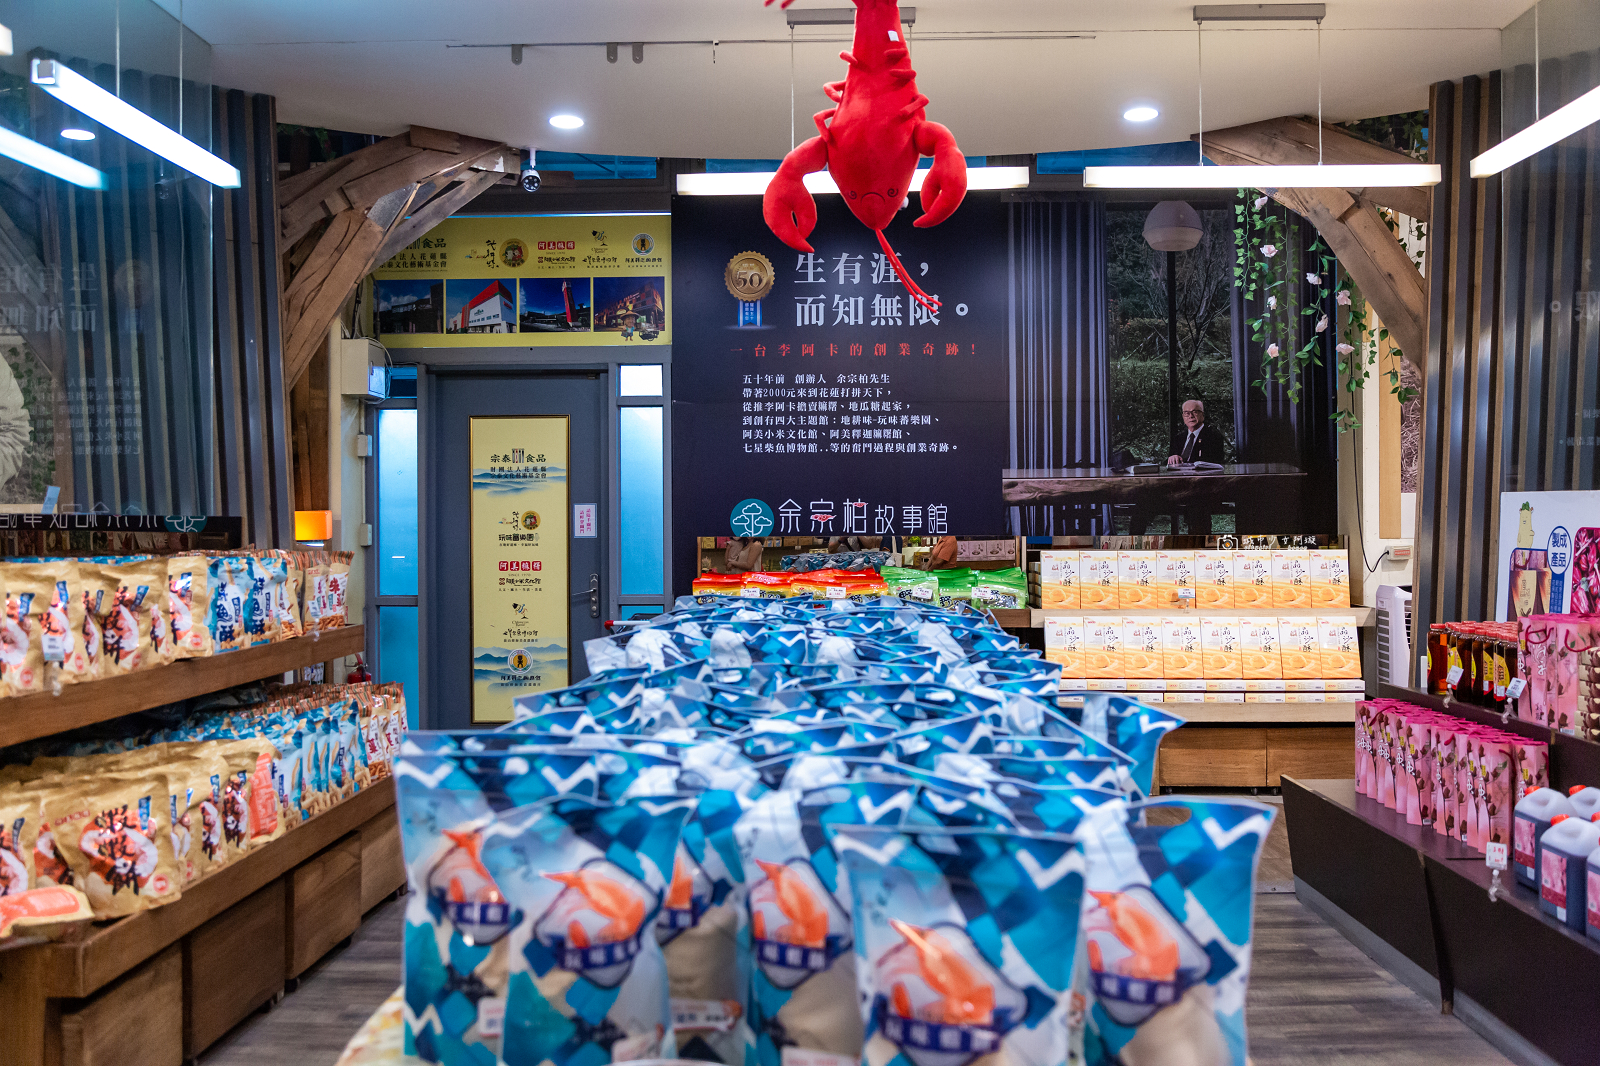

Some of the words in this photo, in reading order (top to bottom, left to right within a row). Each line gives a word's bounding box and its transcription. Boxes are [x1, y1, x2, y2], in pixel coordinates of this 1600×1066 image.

[421, 238, 447, 249] 食品
[736, 270, 763, 289] 50
[795, 294, 970, 328] 而知無限。
[742, 373, 785, 385] 五十年前
[836, 373, 890, 384] 余宗柏先生
[778, 498, 949, 534] 余宗柏故事館
[1551, 532, 1568, 548] 製成
[1550, 552, 1567, 567] 產品
